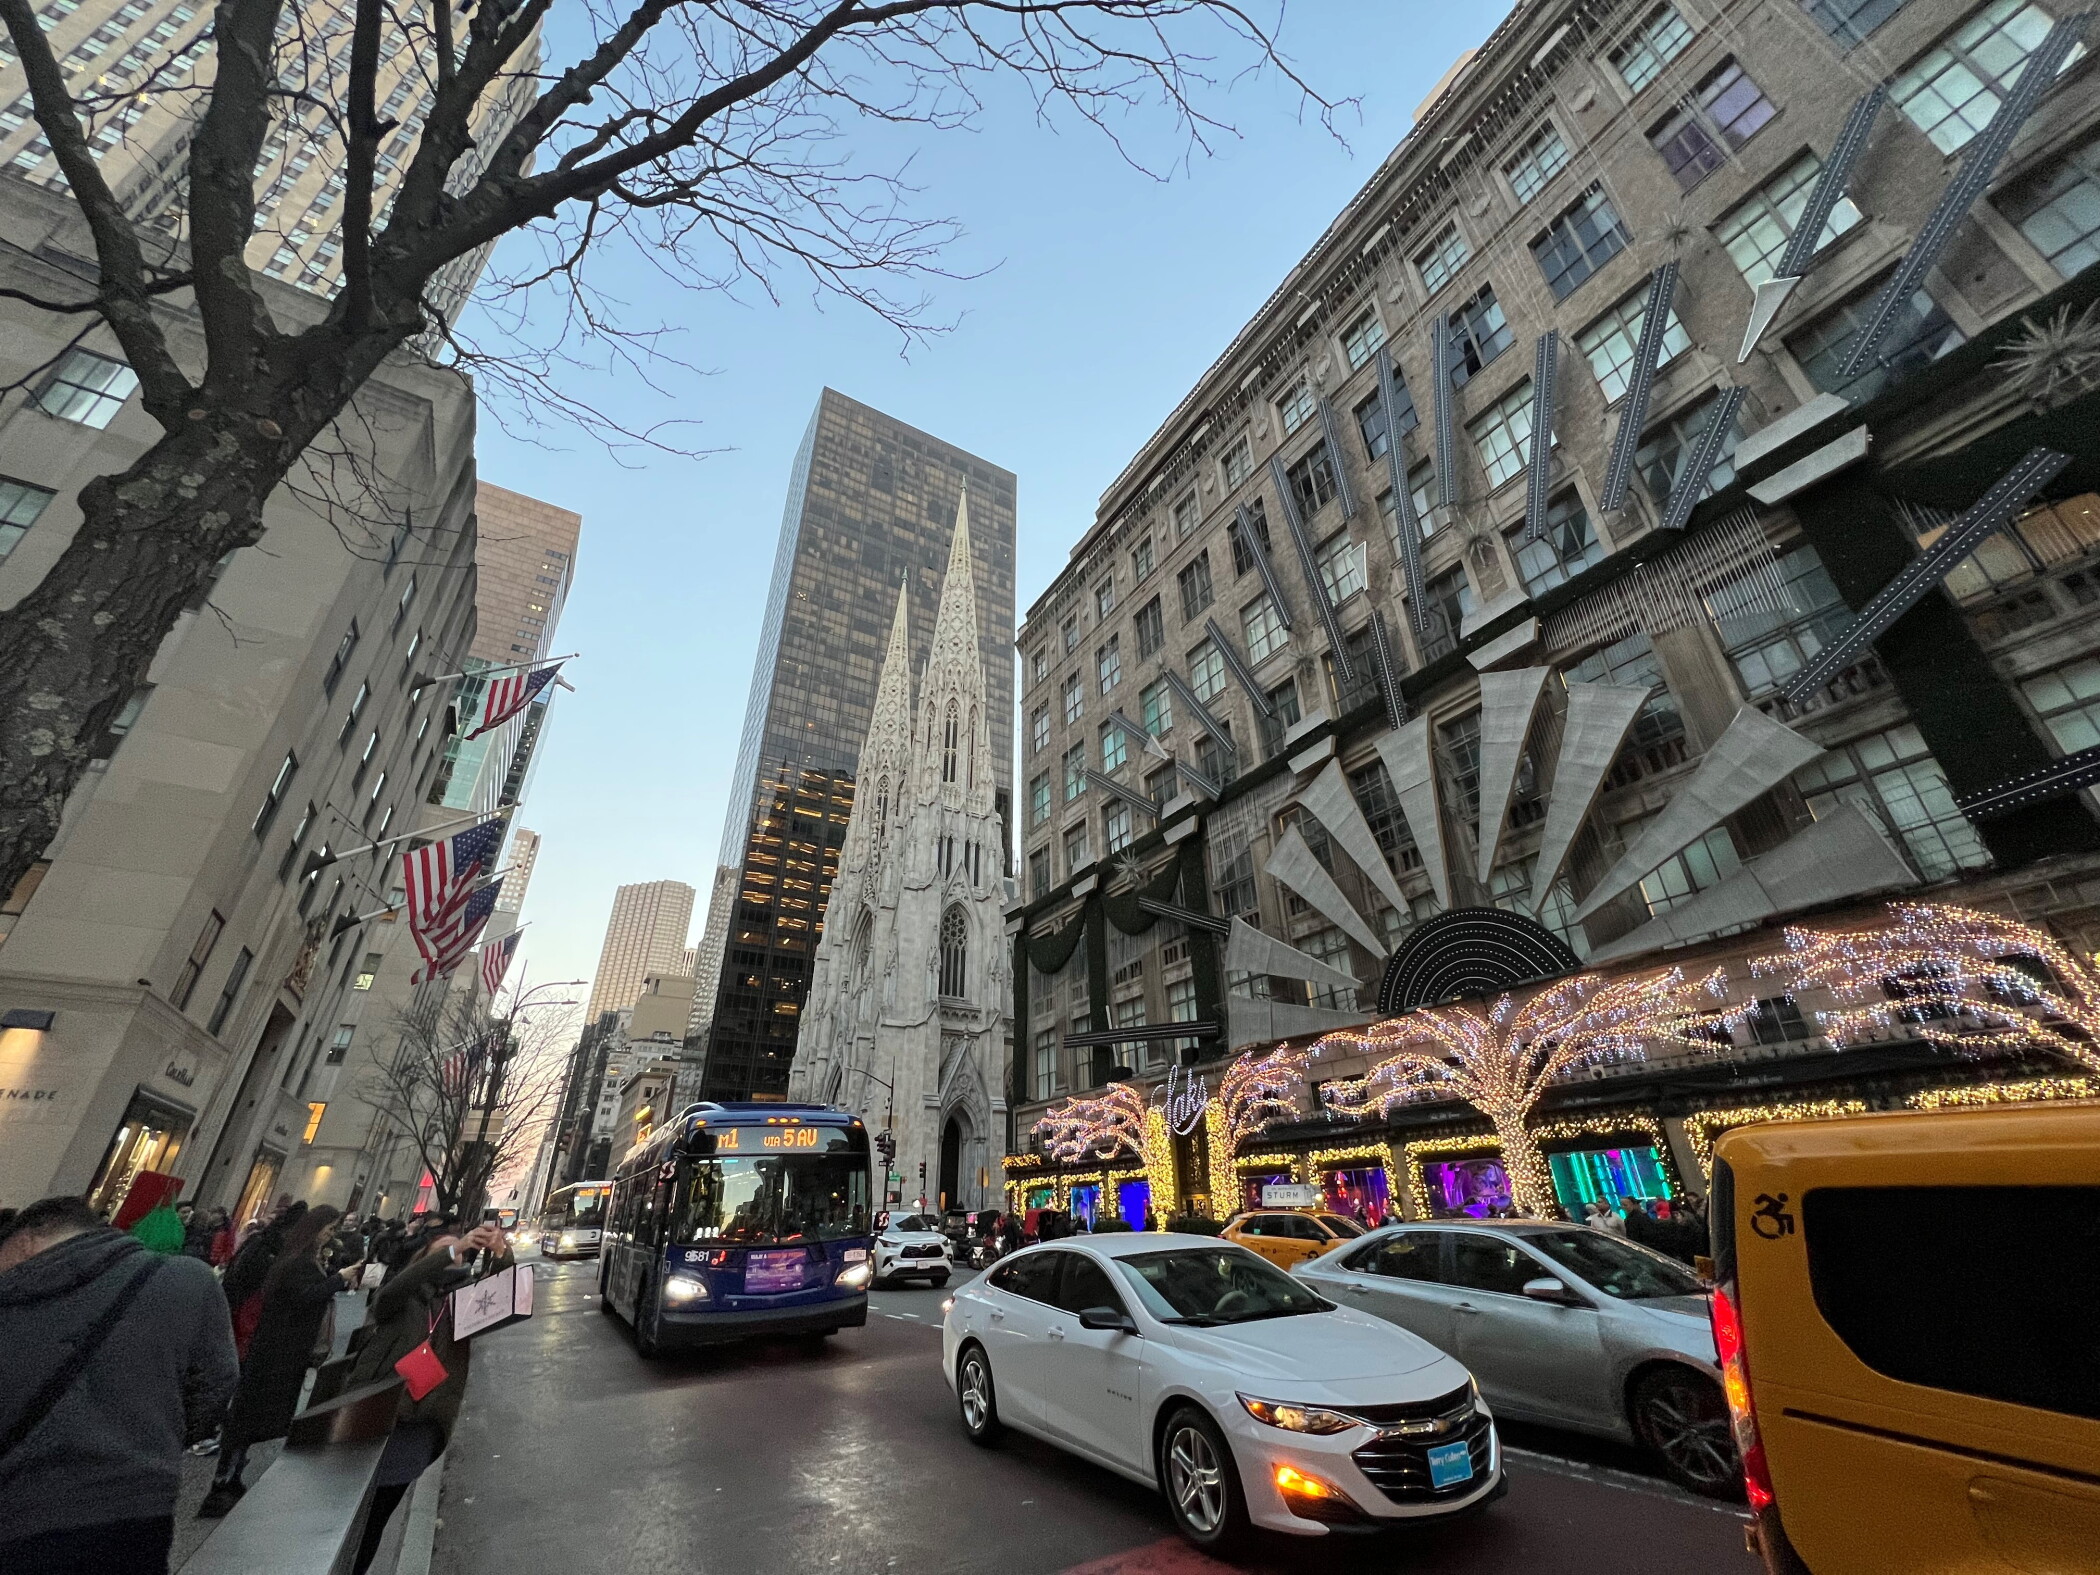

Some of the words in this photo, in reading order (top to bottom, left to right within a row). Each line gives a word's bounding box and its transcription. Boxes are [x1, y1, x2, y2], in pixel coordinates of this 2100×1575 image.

[718, 1128, 739, 1148] M1
[763, 1136, 780, 1147] VIA
[783, 1128, 795, 1147] 5
[796, 1128, 818, 1147] AV
[1266, 1191, 1299, 1199] STURM
